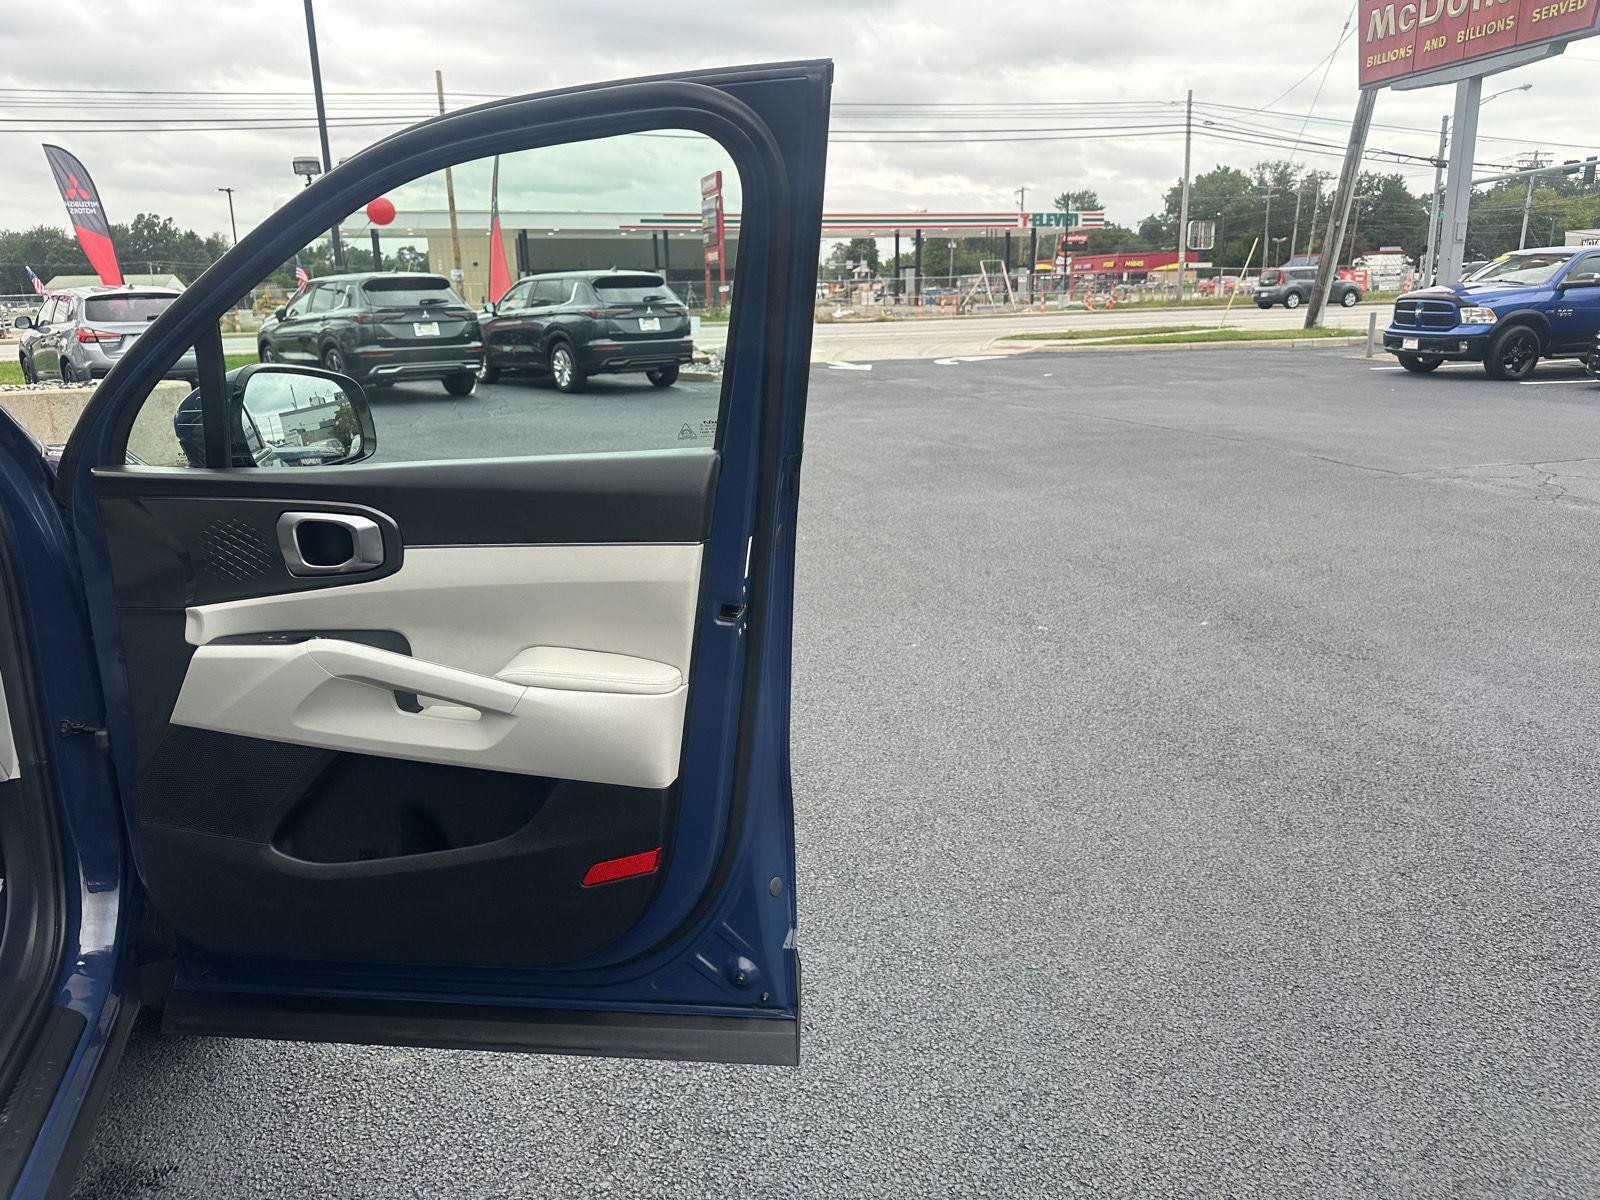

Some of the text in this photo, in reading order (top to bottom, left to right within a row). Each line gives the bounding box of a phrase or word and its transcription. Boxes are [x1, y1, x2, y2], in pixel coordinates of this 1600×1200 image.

[1366, 0, 1508, 43] McDo
[1366, 0, 1588, 68] BILLIONS AND BILLIONS SERVED
